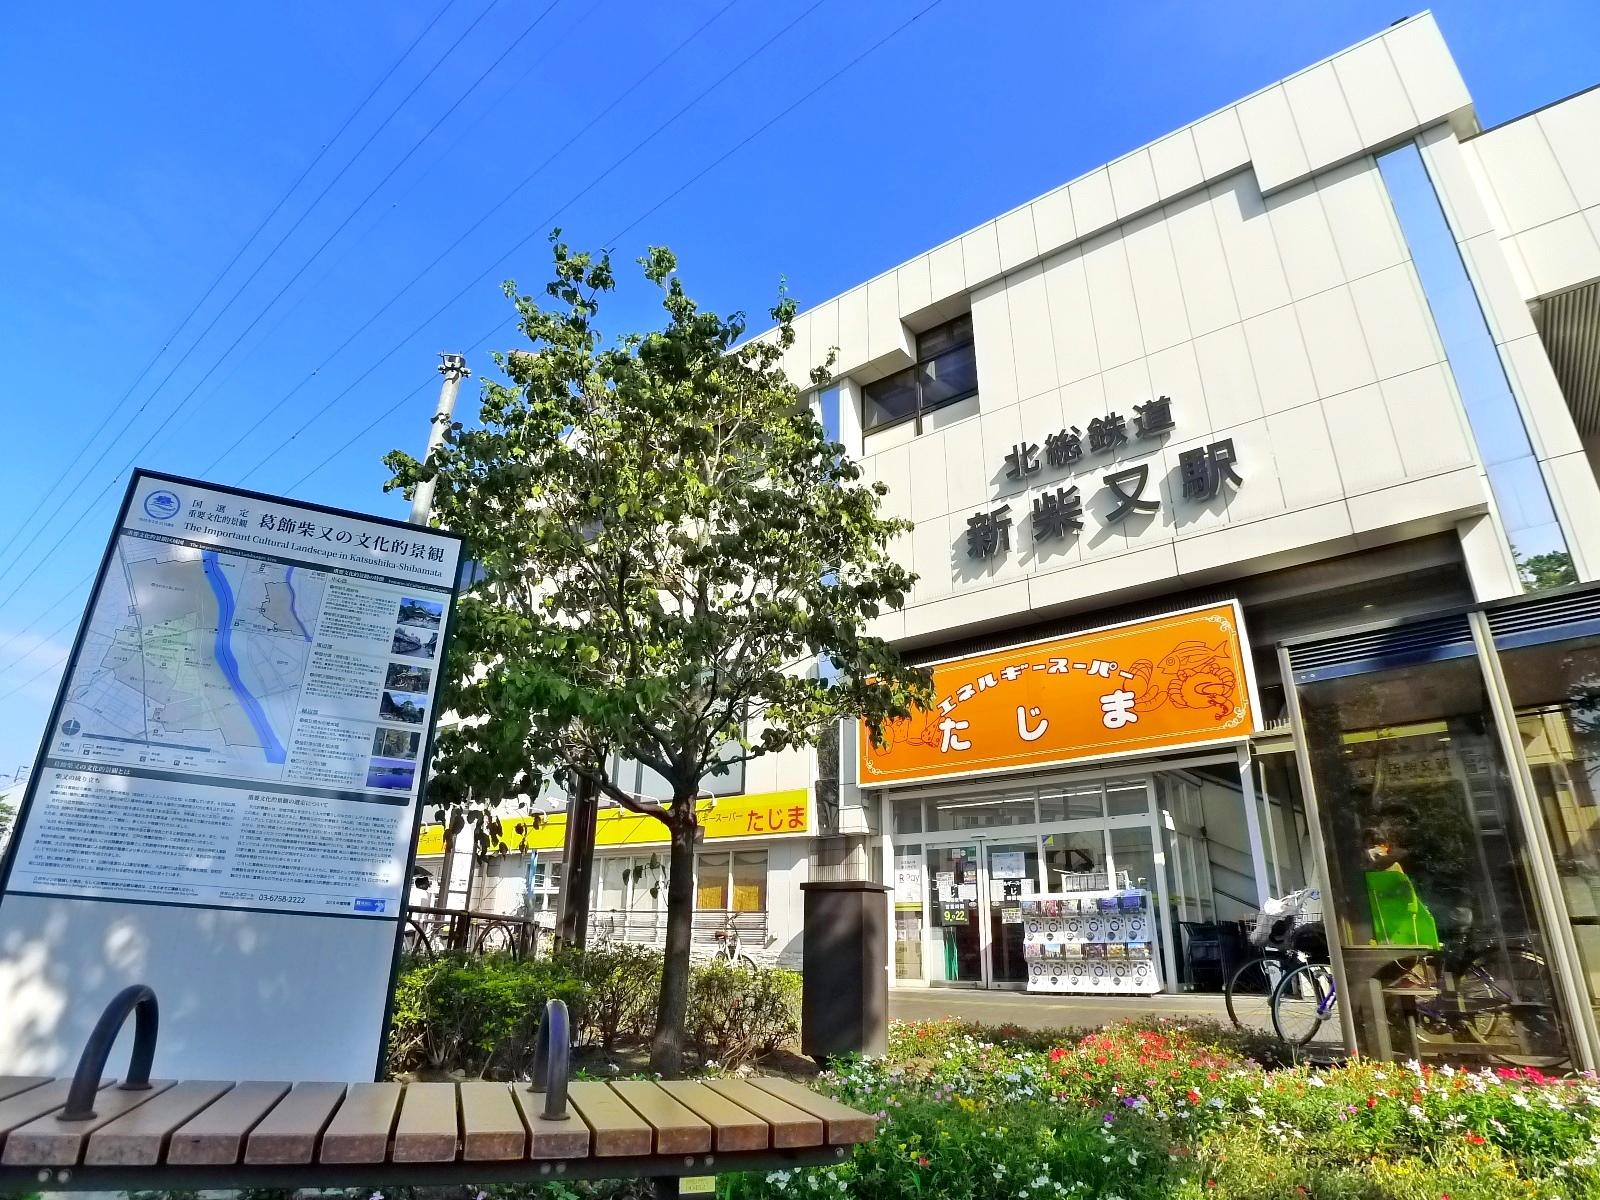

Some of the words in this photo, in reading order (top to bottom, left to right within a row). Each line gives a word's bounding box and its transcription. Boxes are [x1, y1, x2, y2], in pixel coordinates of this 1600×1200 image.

[1005, 396, 1175, 480] 北総鉄道
[188, 509, 249, 528] 重要文化的景観
[966, 438, 1244, 559] 新柴又駅
[184, 522, 203, 532] The
[204, 526, 250, 542] Important
[252, 535, 290, 551] Cultural
[291, 542, 338, 558] Landscape
[349, 553, 443, 578] Katsushika-Shibamata
[258, 512, 445, 563] 葛飾柴又の文化的景観
[936, 656, 1135, 717] エネルギースーパー
[938, 689, 1139, 754] たじま
[747, 806, 805, 831] たじま
[258, 894, 306, 904] 03-6758-2222
